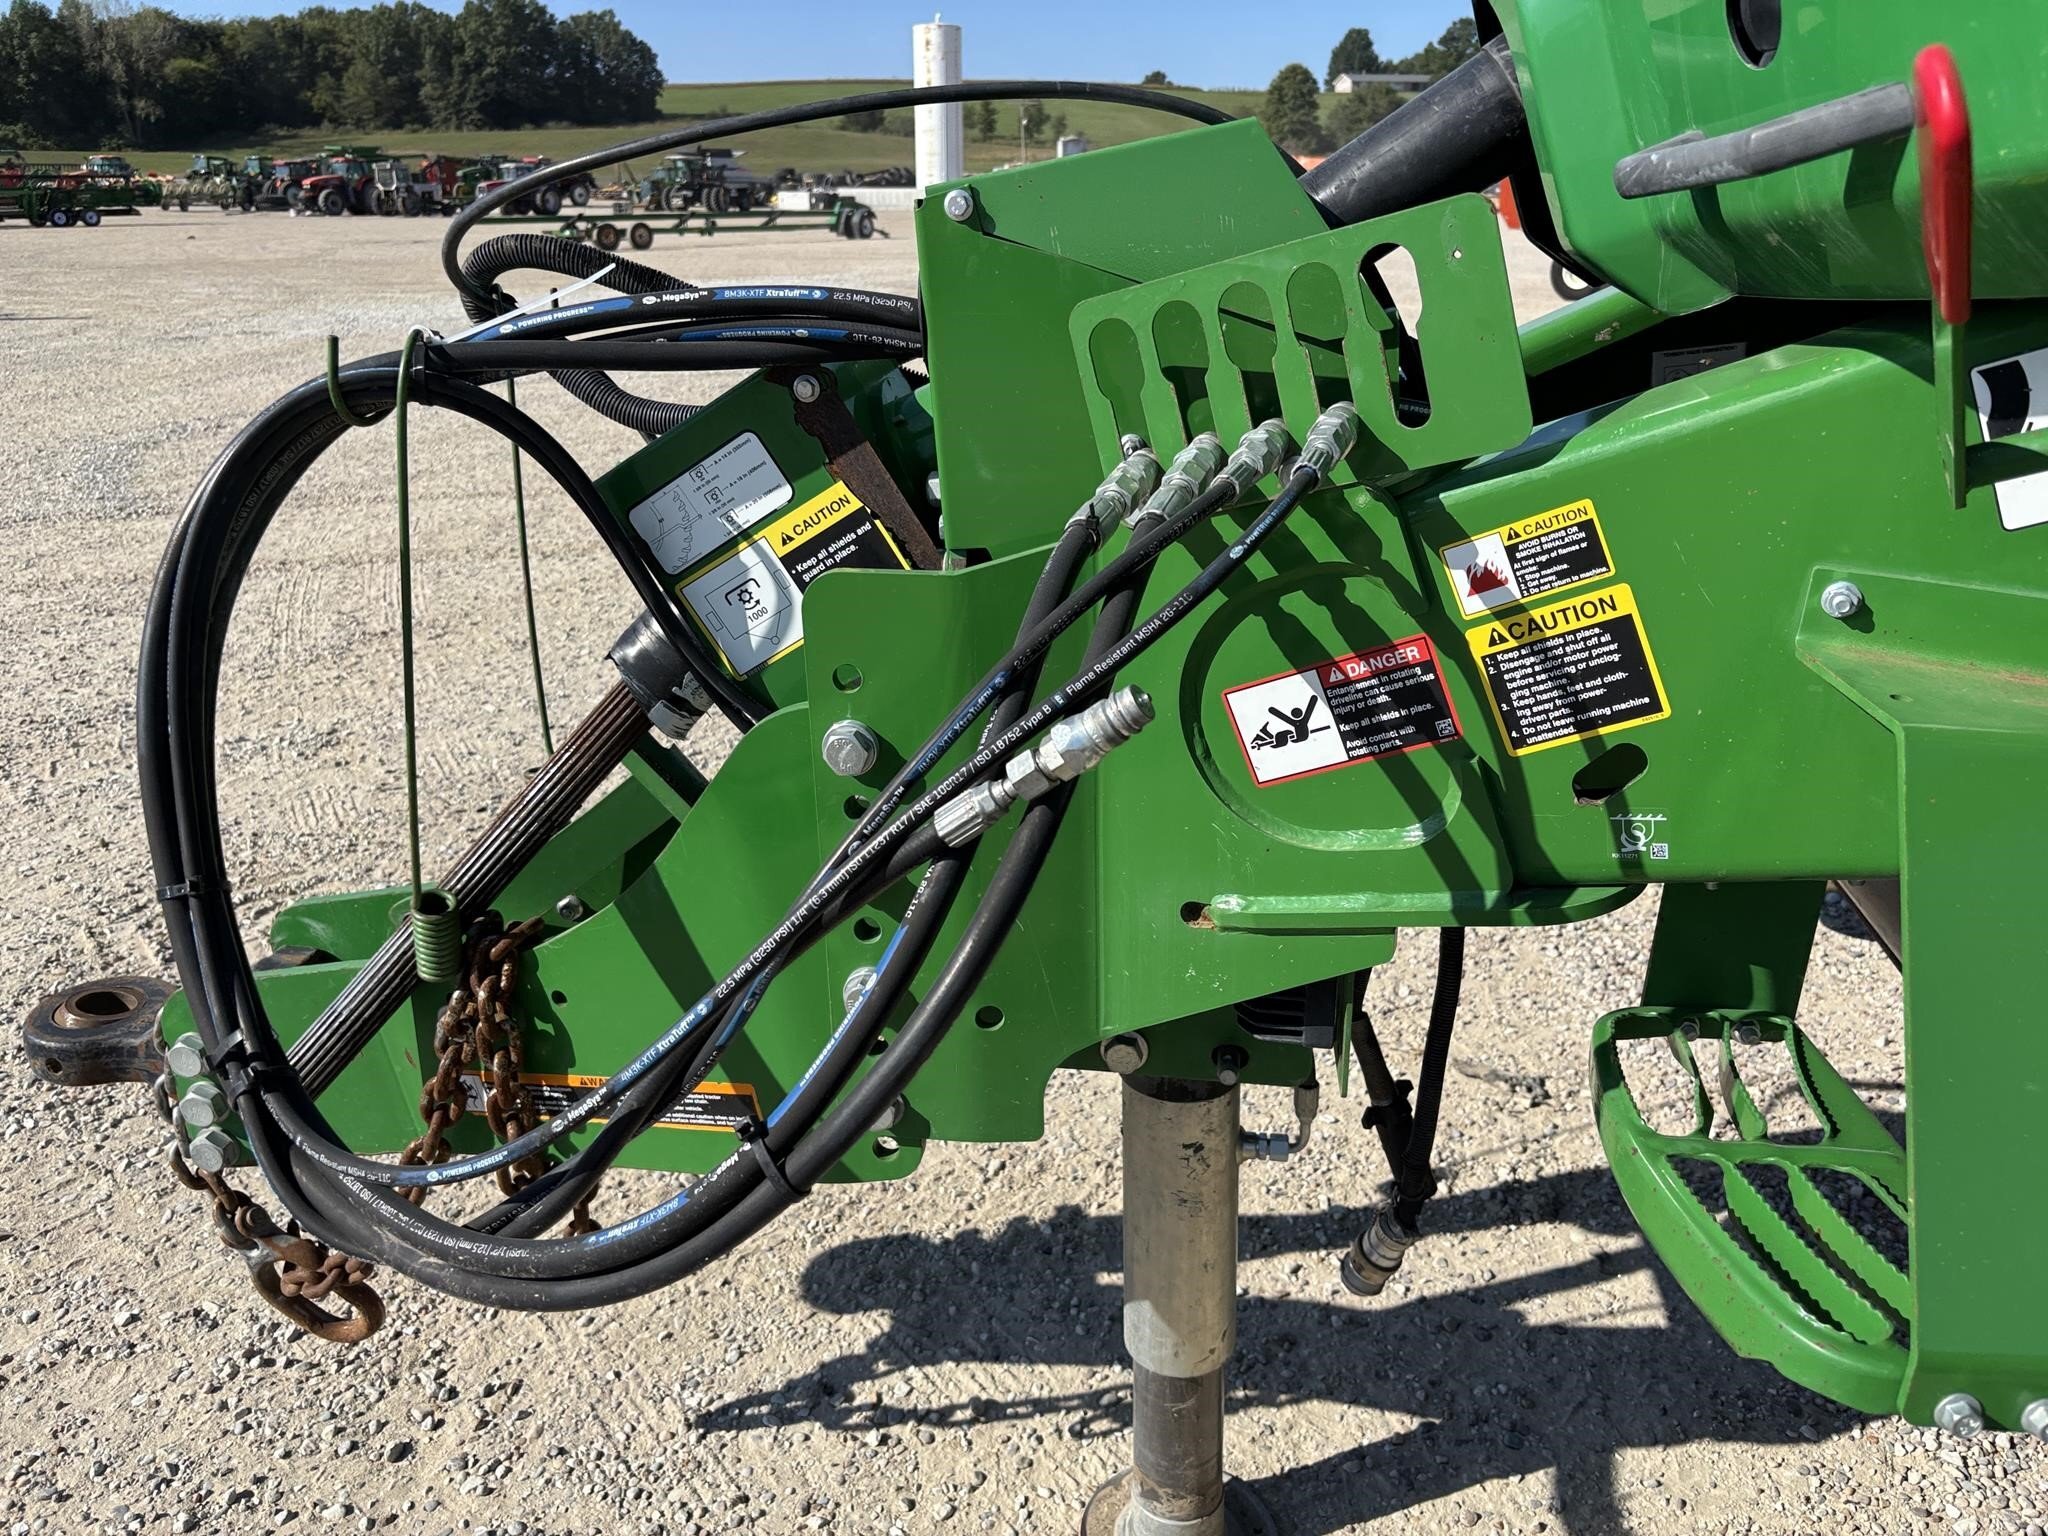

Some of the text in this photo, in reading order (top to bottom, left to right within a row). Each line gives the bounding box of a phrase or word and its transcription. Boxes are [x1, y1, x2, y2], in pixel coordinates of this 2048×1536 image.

[517, 314, 552, 328] POWERING
[724, 289, 764, 297] 8M3K-XTF
[833, 292, 850, 301] 22.5
[852, 294, 869, 303] MPa
[791, 494, 852, 537] CAUTION
[1521, 505, 1588, 536] CAUTION
[795, 521, 872, 573] Keep all shields and
[1515, 531, 1585, 558] SMOKE INHALATION
[1517, 525, 1578, 550] AVOID BURNS OR
[801, 541, 859, 582] guard in place.
[1521, 558, 1535, 567] first
[1535, 553, 1550, 564] sign
[1557, 543, 1579, 555] flames
[1524, 571, 1540, 582] Stop
[1540, 562, 1569, 576] machine.
[1527, 579, 1539, 587] Get
[1539, 574, 1557, 584] away.
[1539, 583, 1551, 591] not
[1551, 577, 1571, 587] return
[1578, 564, 1608, 579] machine.
[747, 605, 769, 622] 1000
[1506, 593, 1617, 641] CAUTION
[1065, 669, 1096, 696] Flame
[1093, 637, 1137, 675] Resistant
[1133, 616, 1162, 642] MSHA
[1346, 645, 1420, 677] DANGER
[1484, 625, 1603, 665] 1. Keep all shields in place.
[1487, 633, 1611, 674] 2. Disengage and shut off all
[1503, 642, 1619, 681] engine and/or motor power
[1506, 675, 1534, 689] before
[1535, 664, 1576, 682] servicing
[1587, 651, 1622, 668] unclog-
[1326, 665, 1422, 699] Entanglement in rotating
[1329, 671, 1434, 706] driveline can cause serious
[1509, 676, 1570, 700] ging machine.
[1512, 695, 1536, 709] Keep
[1535, 687, 1566, 702] hands,
[1566, 682, 1584, 692] feet
[1584, 677, 1602, 688] and
[1602, 669, 1629, 683] cloth-
[1333, 702, 1356, 716] injury
[1365, 693, 1391, 706] death.
[1339, 701, 1434, 733] Keep all shields in place.
[1516, 686, 1608, 718] ing away from power-
[1519, 706, 1574, 726] driven parts.
[1522, 725, 1535, 735] Do
[1536, 721, 1552, 731] not
[1552, 715, 1575, 727] leave
[1576, 705, 1611, 722] running
[1611, 695, 1650, 711] machine
[1345, 725, 1416, 748] Avoid contact with
[1348, 738, 1403, 758] rotating parts.
[1525, 725, 1576, 744] unattended.
[619, 1047, 659, 1082] 4M3K-XTF
[714, 978, 735, 998] 22.5
[732, 961, 753, 981] MPa
[845, 855, 863, 873] ISO
[888, 814, 910, 835] R17
[912, 794, 934, 814] SAE
[931, 767, 969, 799] 100R17
[973, 749, 992, 766] ISO
[989, 726, 1022, 754] 18752
[1020, 710, 1045, 733] Type
[1041, 703, 1052, 714] B
[442, 1164, 472, 1177] POWERING
